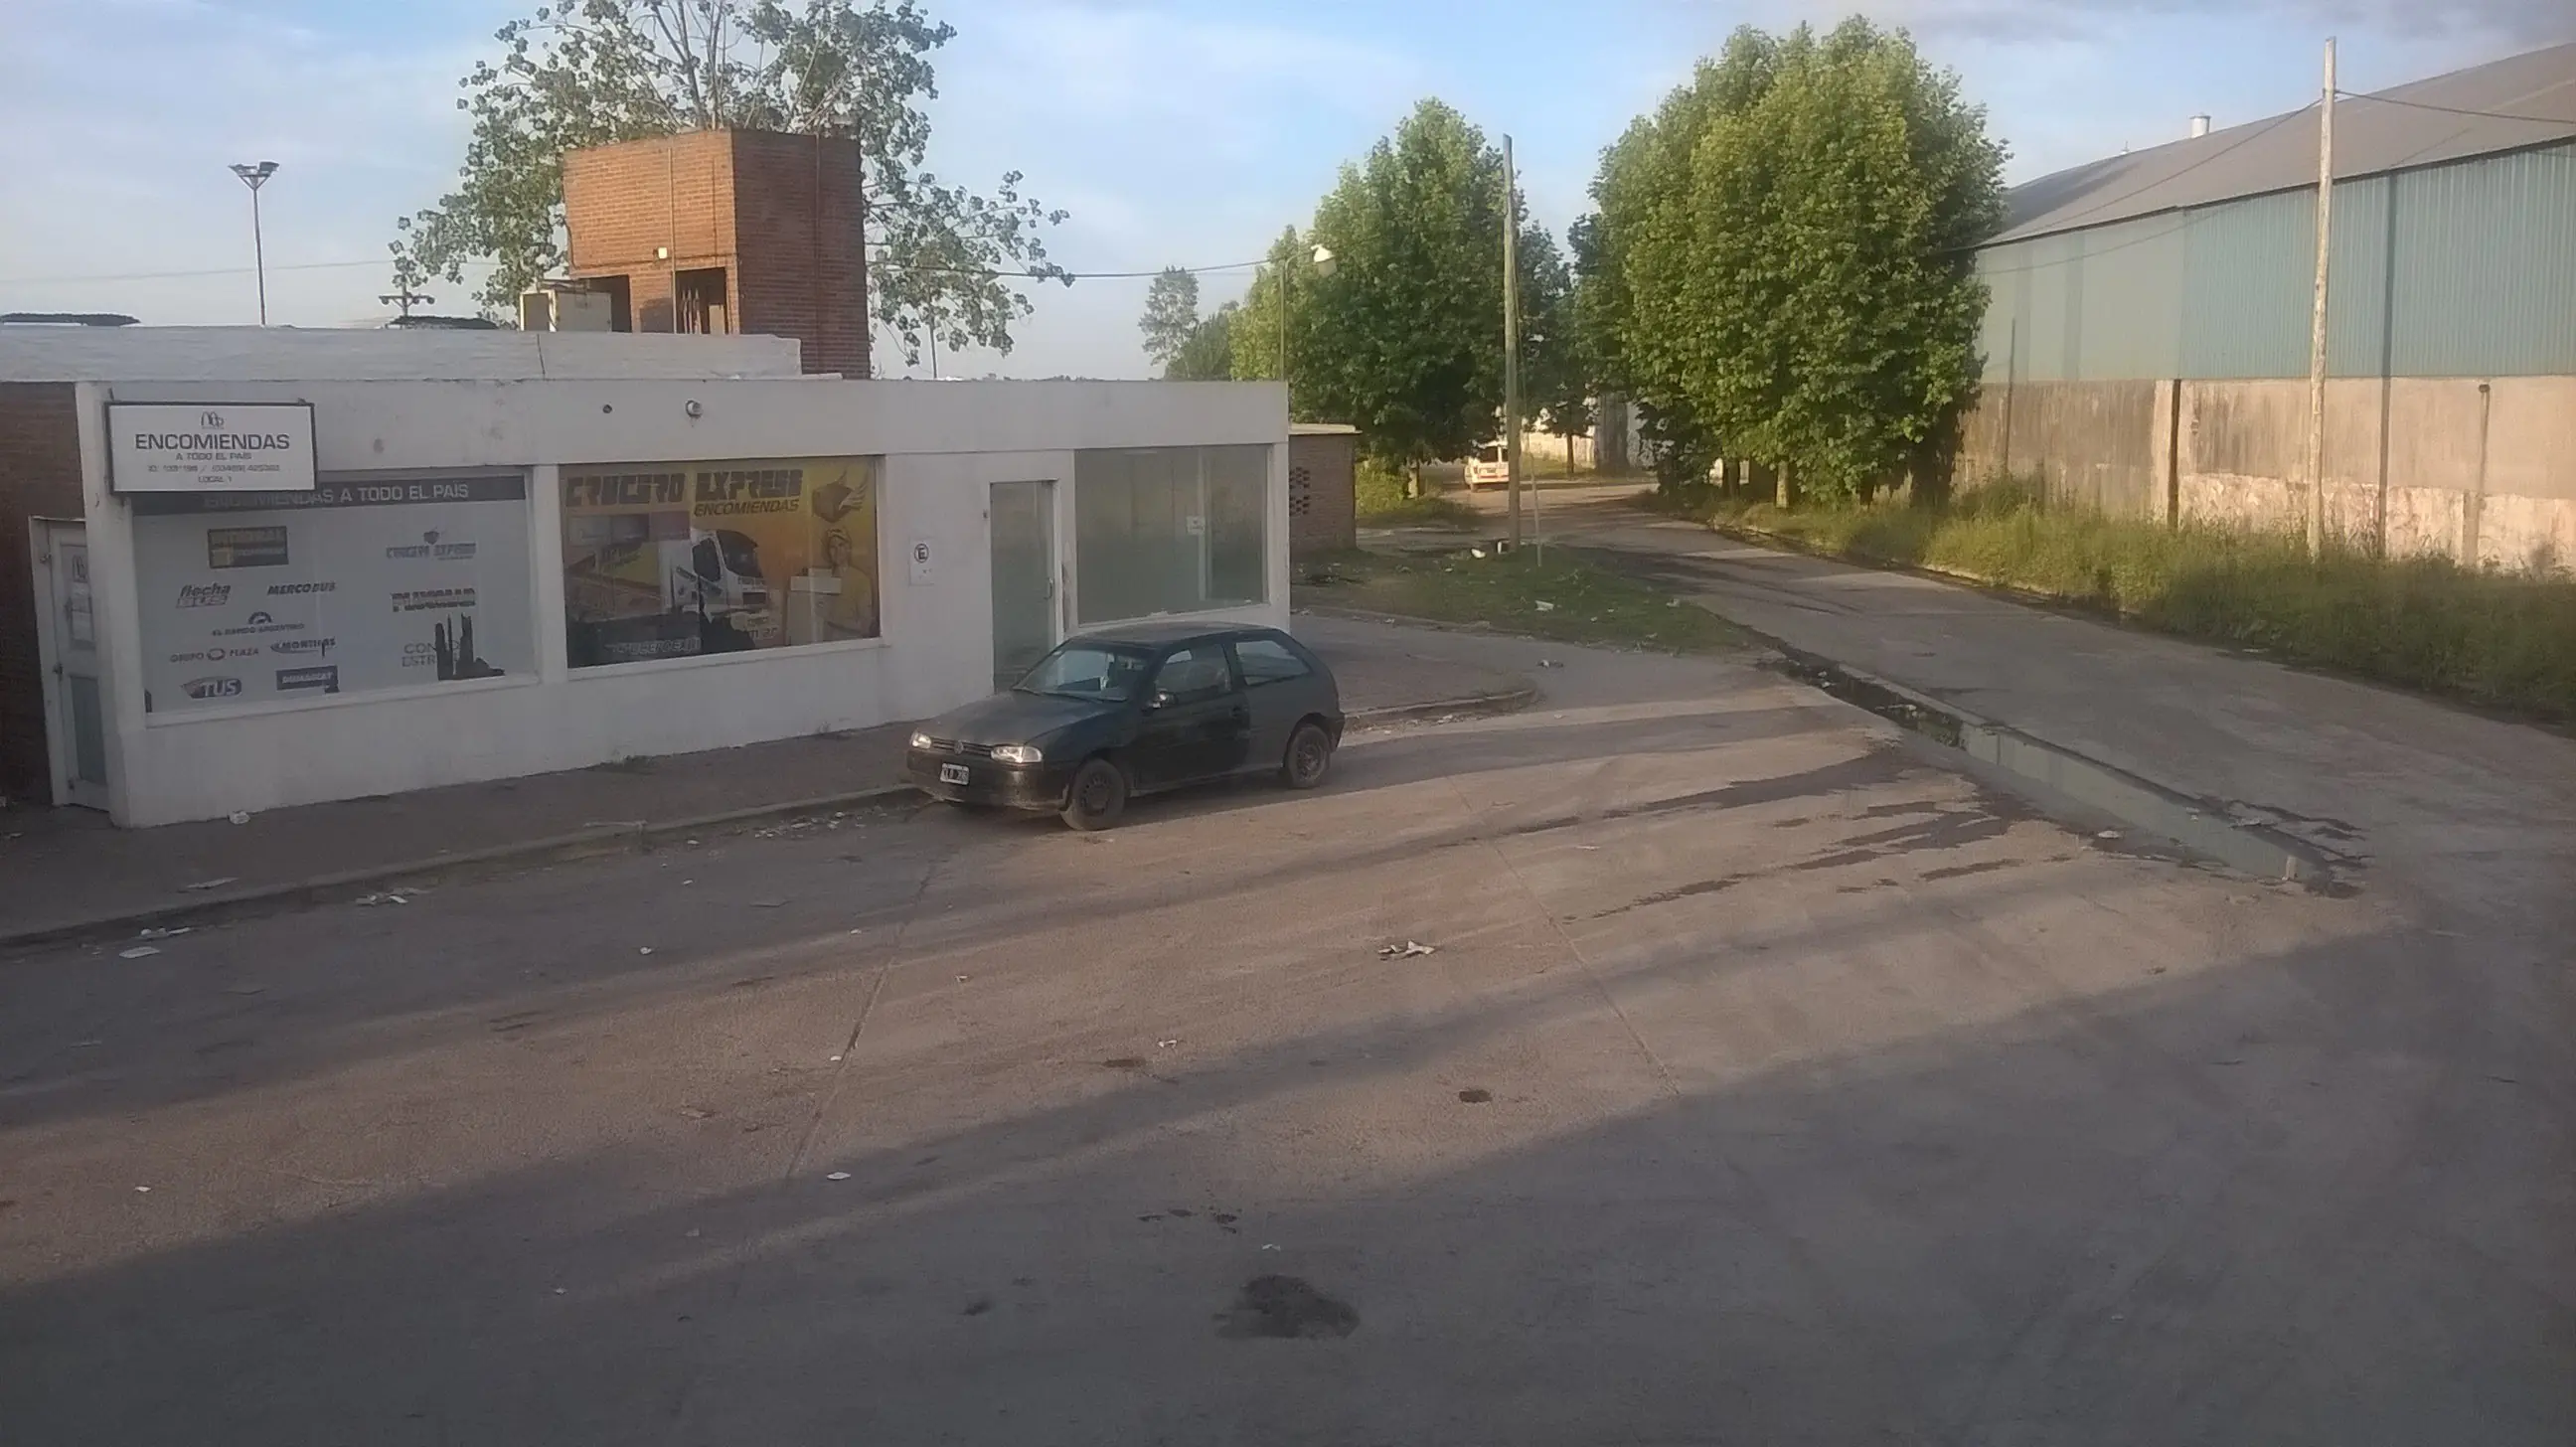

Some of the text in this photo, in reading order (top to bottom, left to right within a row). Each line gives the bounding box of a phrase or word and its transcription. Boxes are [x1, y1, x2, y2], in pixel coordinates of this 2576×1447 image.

[134, 433, 290, 450] ENCOMIENDAS
[175, 452, 184, 461] A
[187, 452, 213, 461] TODO
[339, 490, 354, 503] A
[357, 487, 402, 502] TODO
[408, 487, 430, 500] EL
[565, 469, 804, 508] CRUCERO EXPRESS
[693, 498, 800, 518] ENCOMIENDAS
[203, 679, 239, 696] TUS
